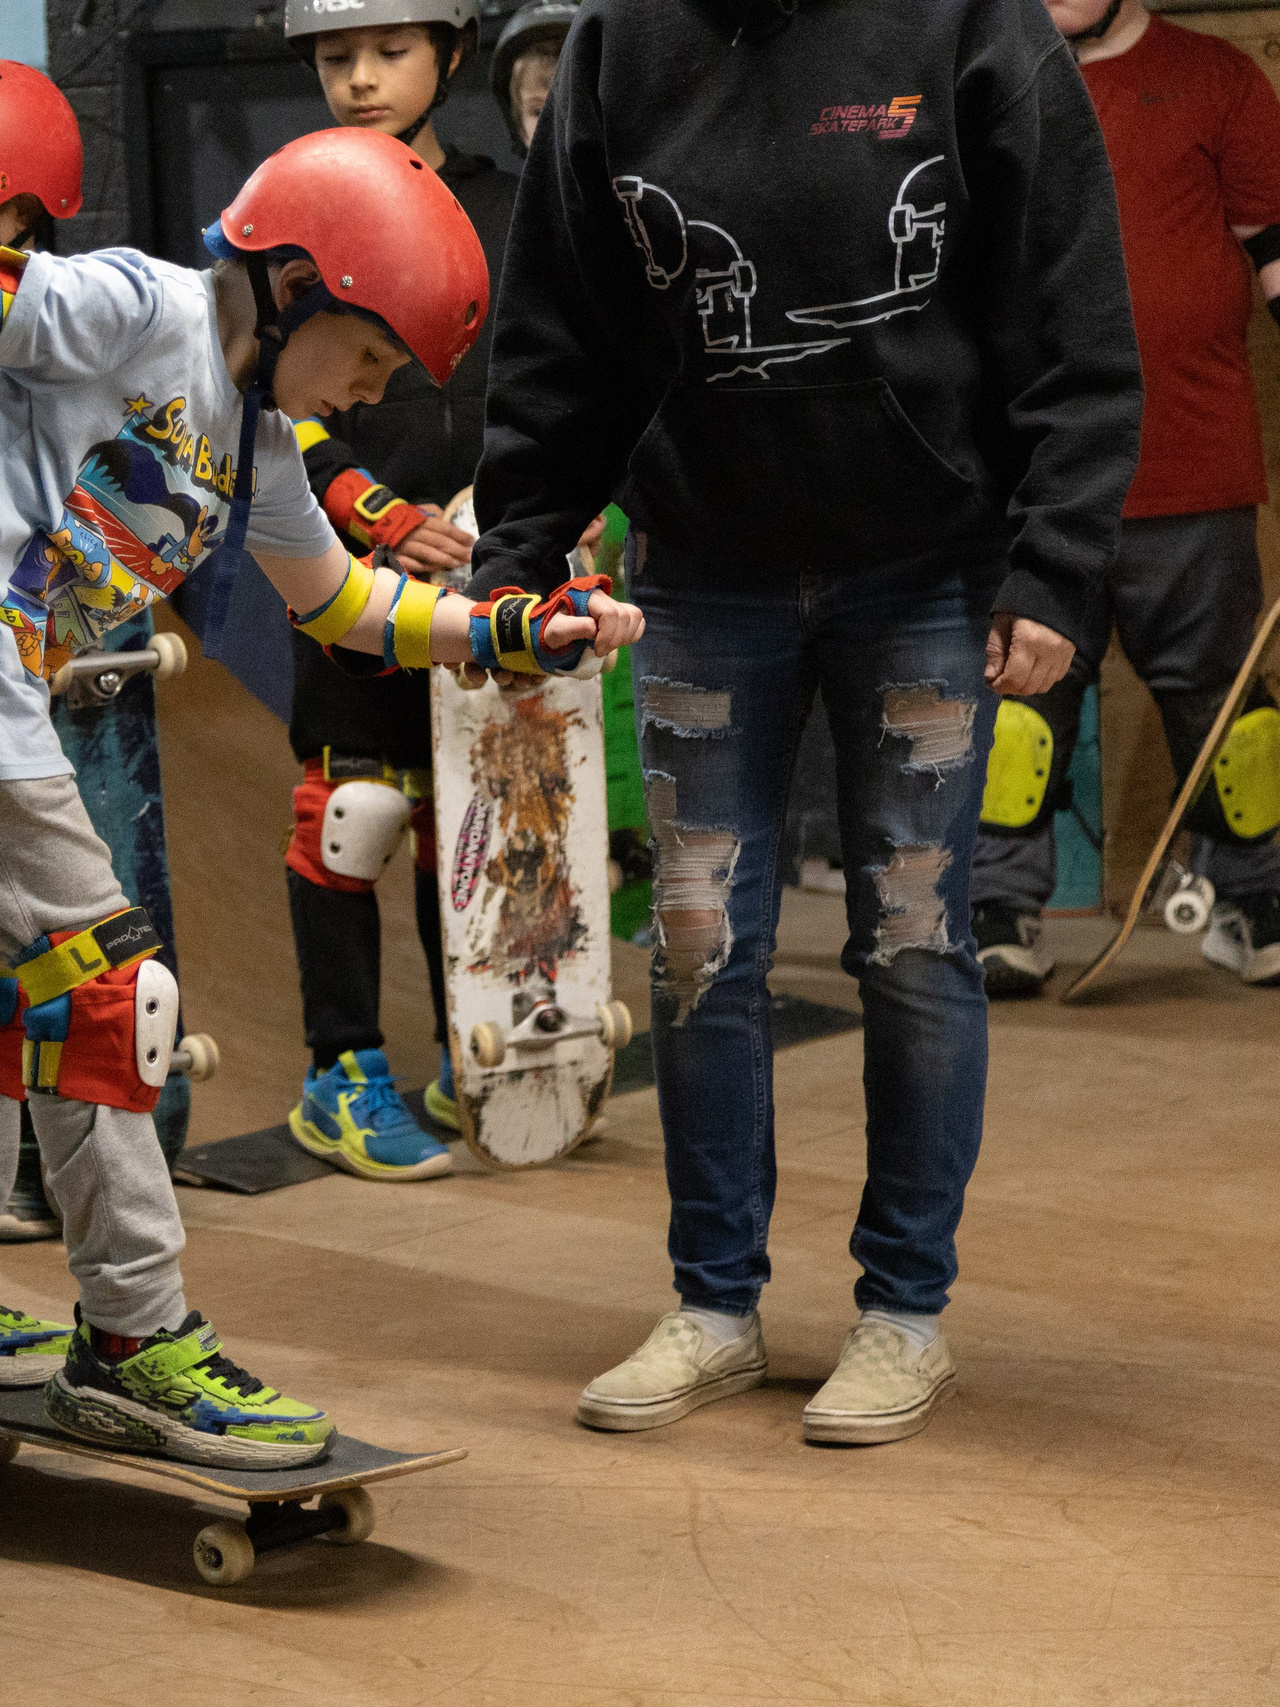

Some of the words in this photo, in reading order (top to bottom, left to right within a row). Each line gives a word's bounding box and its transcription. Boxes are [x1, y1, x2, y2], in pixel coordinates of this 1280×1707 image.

[820, 104, 888, 121] CINEMA
[878, 95, 923, 139] 5
[807, 118, 898, 136] SKATEPARK
[105, 933, 130, 950] PRO
[69, 947, 103, 974] L
